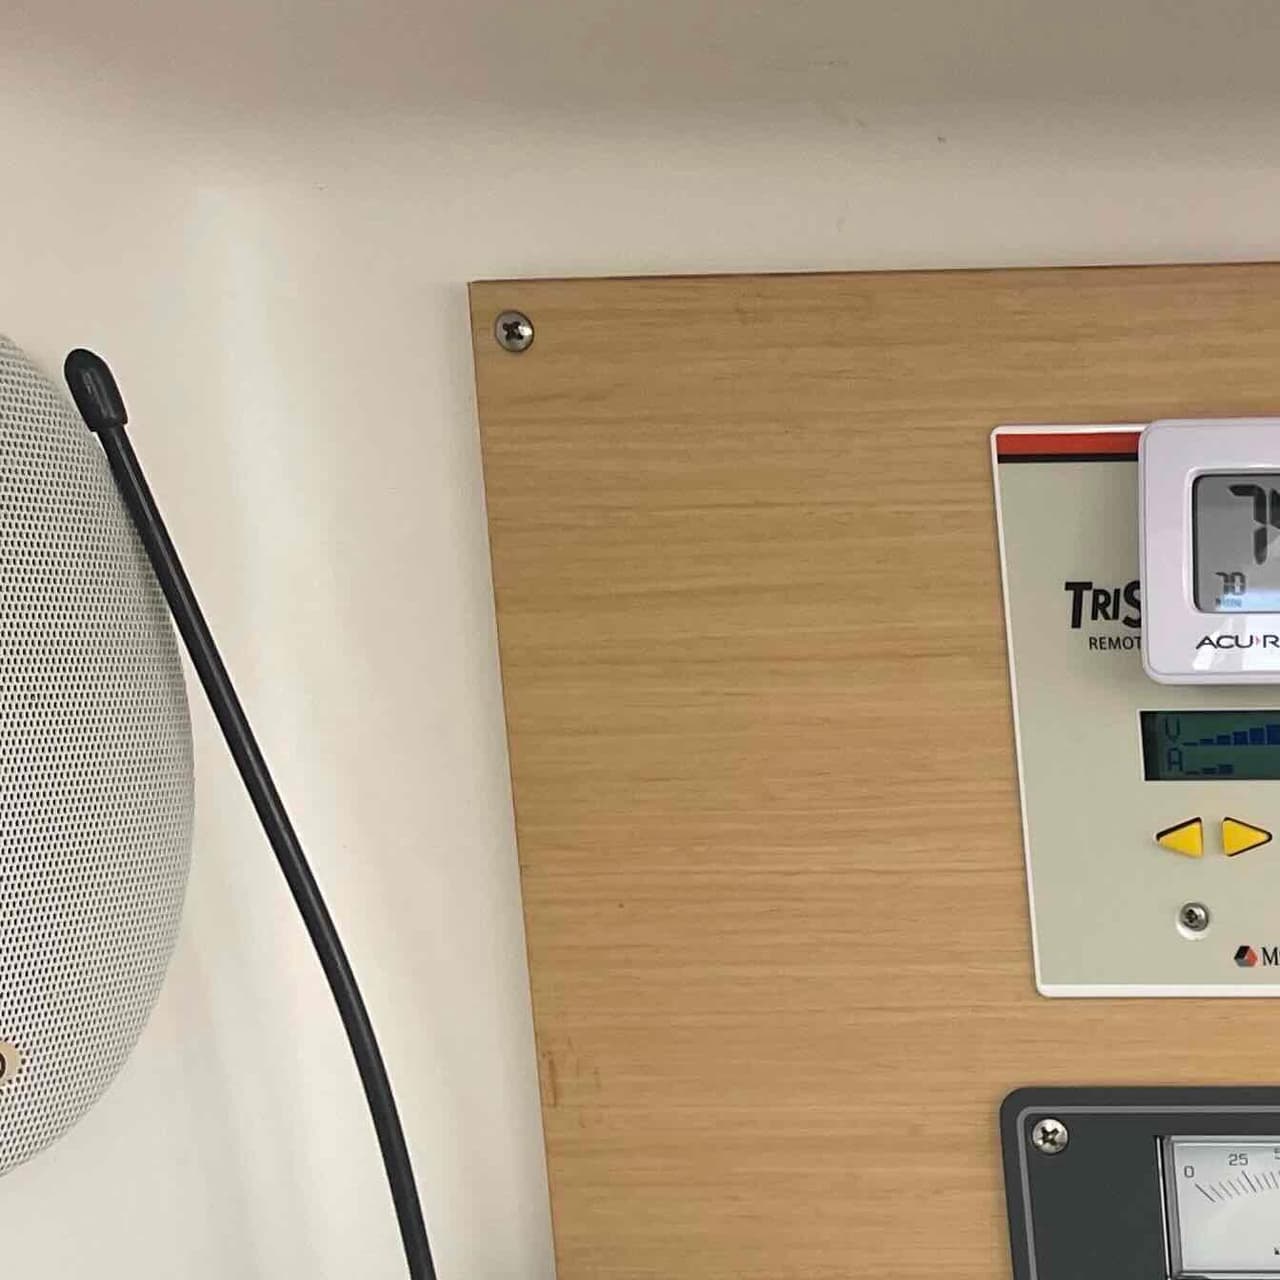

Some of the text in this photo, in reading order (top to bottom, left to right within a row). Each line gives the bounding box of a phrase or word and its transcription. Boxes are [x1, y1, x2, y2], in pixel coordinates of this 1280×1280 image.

[1065, 580, 1141, 629] TRIS
[1088, 636, 1141, 650] REMOT
[1183, 1166, 1195, 1178] 0
[1228, 1153, 1249, 1166] 25
